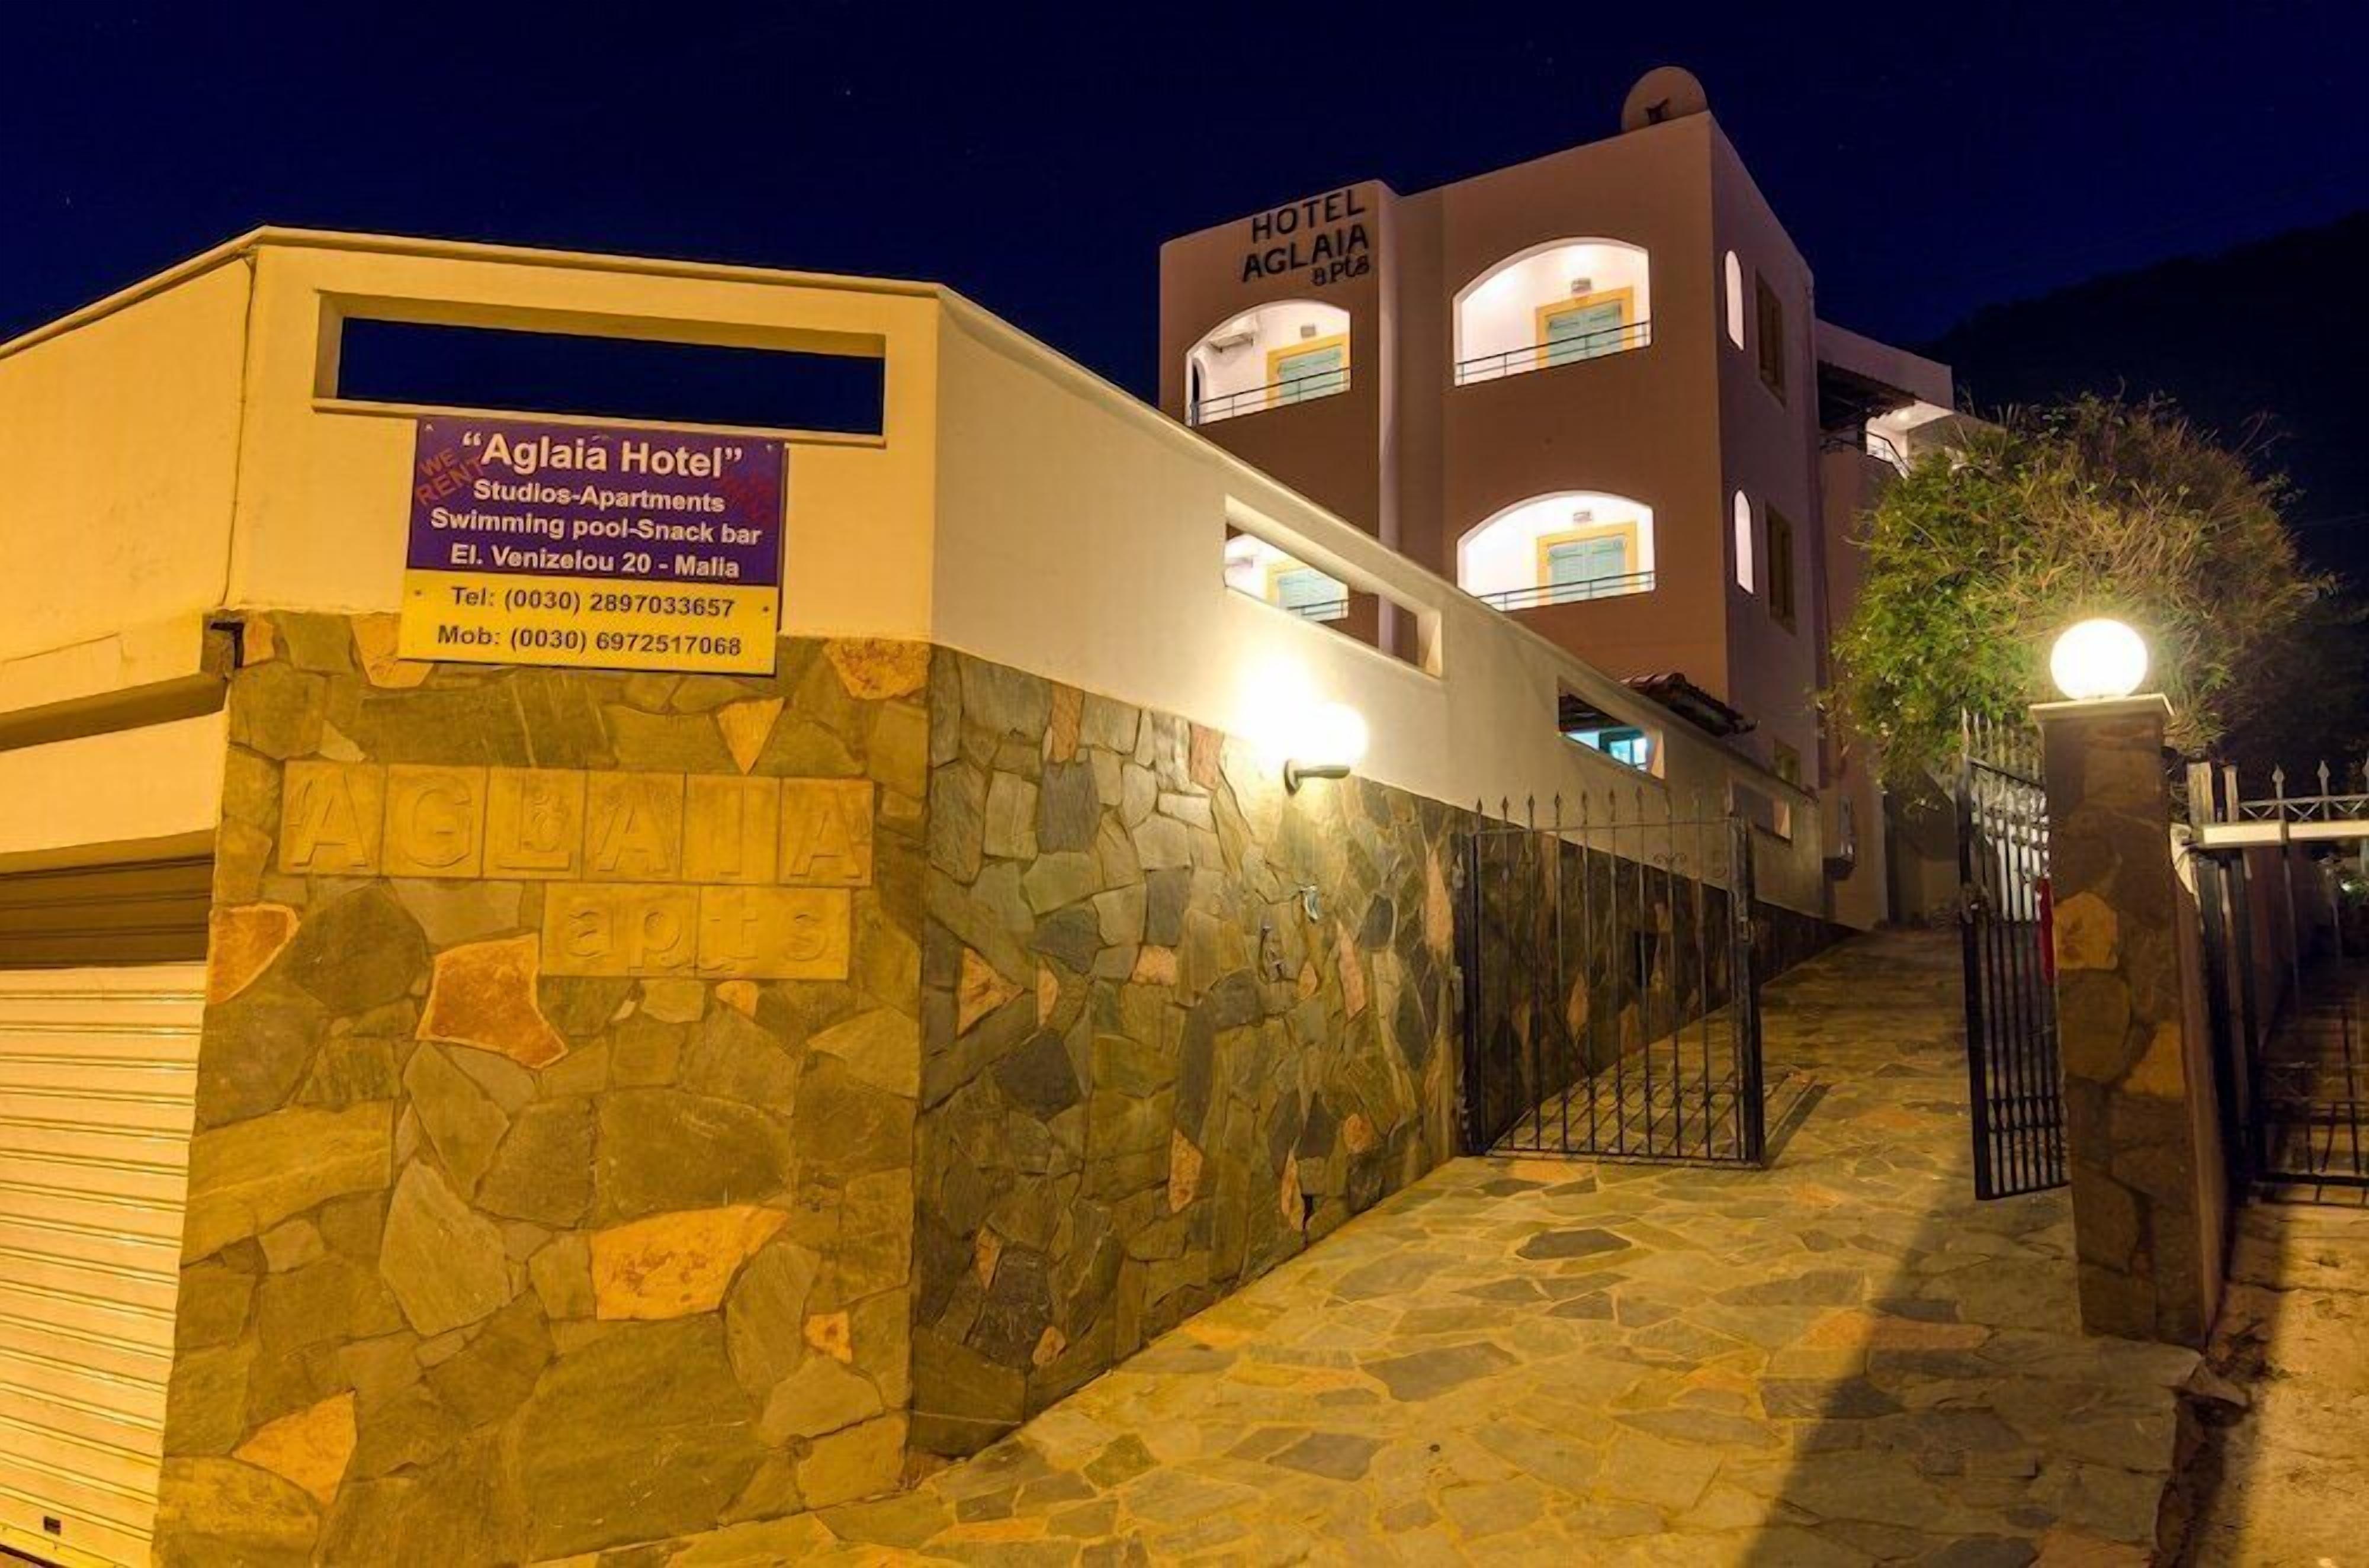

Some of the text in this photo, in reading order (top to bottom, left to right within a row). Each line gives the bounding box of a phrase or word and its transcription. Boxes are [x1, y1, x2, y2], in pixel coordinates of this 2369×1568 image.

[1251, 189, 1365, 243] HOTEL
[1242, 224, 1369, 282] AGLAIA
[419, 448, 454, 477] WE
[621, 441, 742, 478] Hotel”
[417, 455, 484, 506] RENT
[474, 478, 726, 513] Studios-Apartments
[431, 507, 763, 545] Swimming pool-Snack bar
[451, 543, 483, 565] El.
[491, 545, 615, 571] Venizelou
[622, 552, 652, 573] 20
[675, 554, 740, 577] Malia
[452, 586, 735, 618] Tel: (0030) 2897033657
[438, 625, 742, 656] Mob: (0030) 6972517068
[290, 770, 865, 880] AGLAIA
